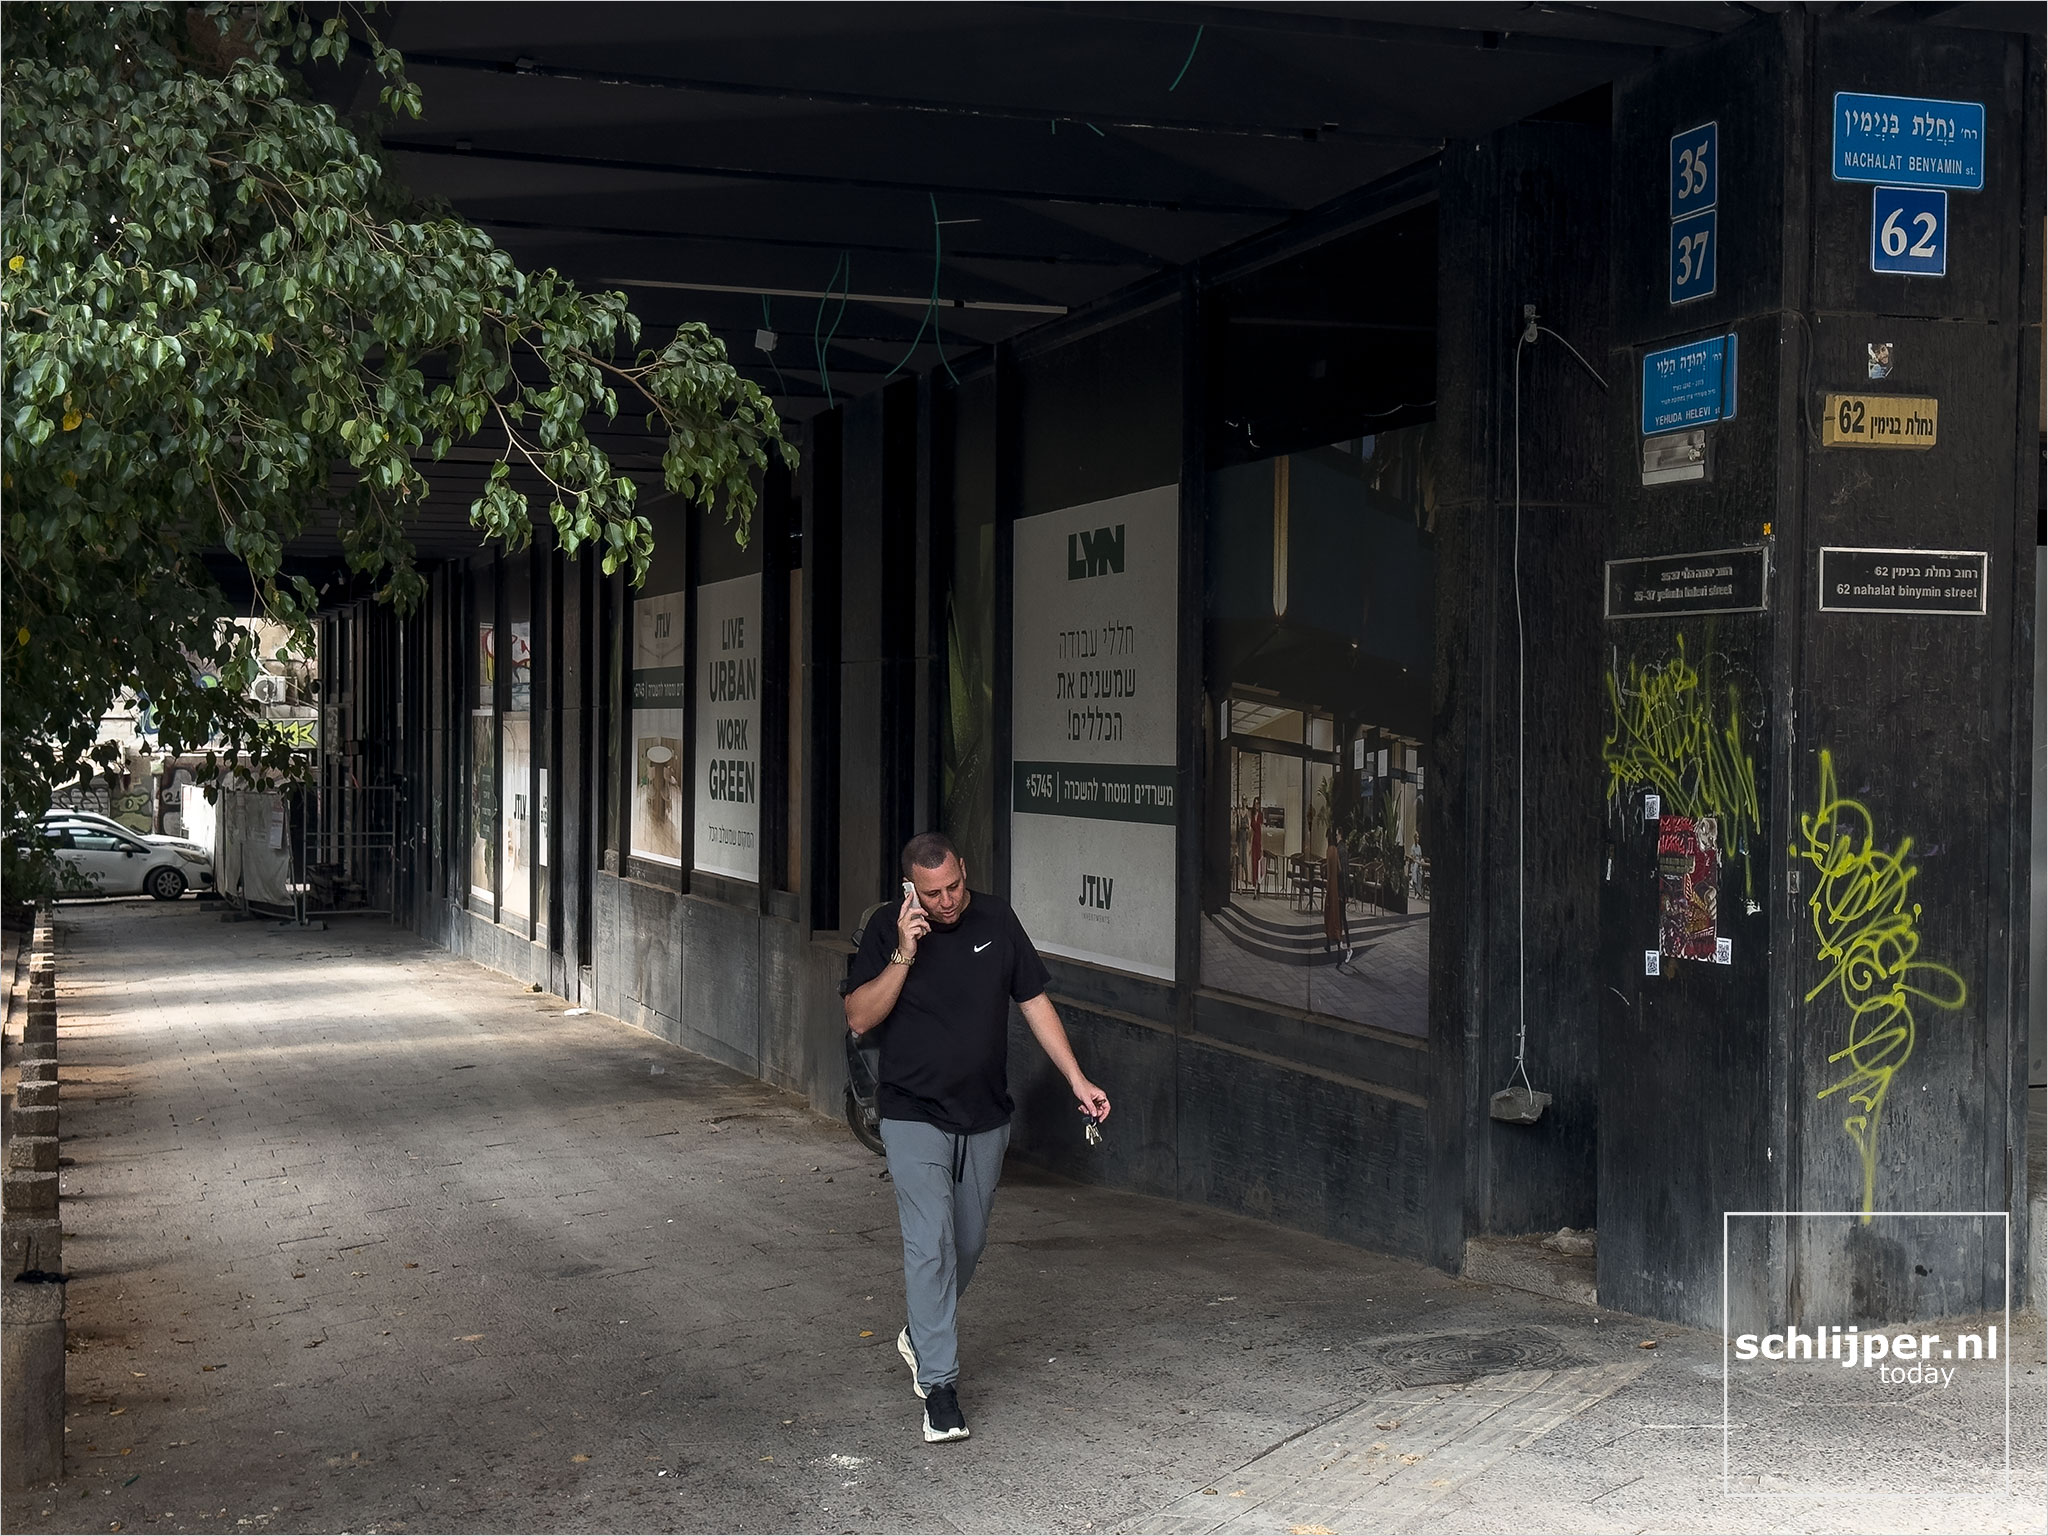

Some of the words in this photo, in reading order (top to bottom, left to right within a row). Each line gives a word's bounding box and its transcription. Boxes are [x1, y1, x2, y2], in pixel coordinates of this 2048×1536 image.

[1678, 140, 1708, 199] 35
[1844, 151, 1902, 170] NACHALAT
[1909, 156, 1962, 175] BENYAMIN
[1965, 165, 1976, 176] st.
[1881, 208, 1937, 258] 62
[1677, 230, 1709, 285] 37
[1655, 411, 1683, 426] YEHUDA
[1685, 406, 1711, 421] HELEVI
[1839, 400, 1865, 434] 62
[1870, 416, 1901, 440] בנימין
[1905, 411, 1934, 436] נחלת
[1068, 523, 1125, 580] LYN
[1874, 566, 1889, 577] 62
[1892, 566, 1921, 580] בנימין
[1924, 565, 1951, 578] נחלת
[1954, 569, 1979, 579] רחוב
[1836, 583, 1851, 596] 62
[1853, 584, 1896, 597] nahalat
[1898, 585, 1941, 600] binymin
[1944, 587, 1978, 598] street
[655, 612, 671, 639] JTLV
[722, 617, 744, 650] LIVE
[1102, 620, 1134, 655] חללי
[1059, 628, 1097, 659] עבודה
[709, 657, 756, 702] URBAN
[1057, 672, 1076, 700] את
[1080, 669, 1136, 699] שמשנים
[717, 719, 748, 751] WORK
[1068, 706, 1122, 741] הכללים!
[709, 758, 755, 804] GREEN
[1064, 777, 1099, 802] להשכרה
[1101, 782, 1132, 804] ומסחר
[514, 794, 527, 821] JTLV
[1134, 784, 1173, 807] משרדים
[1079, 874, 1114, 910] JTLV
